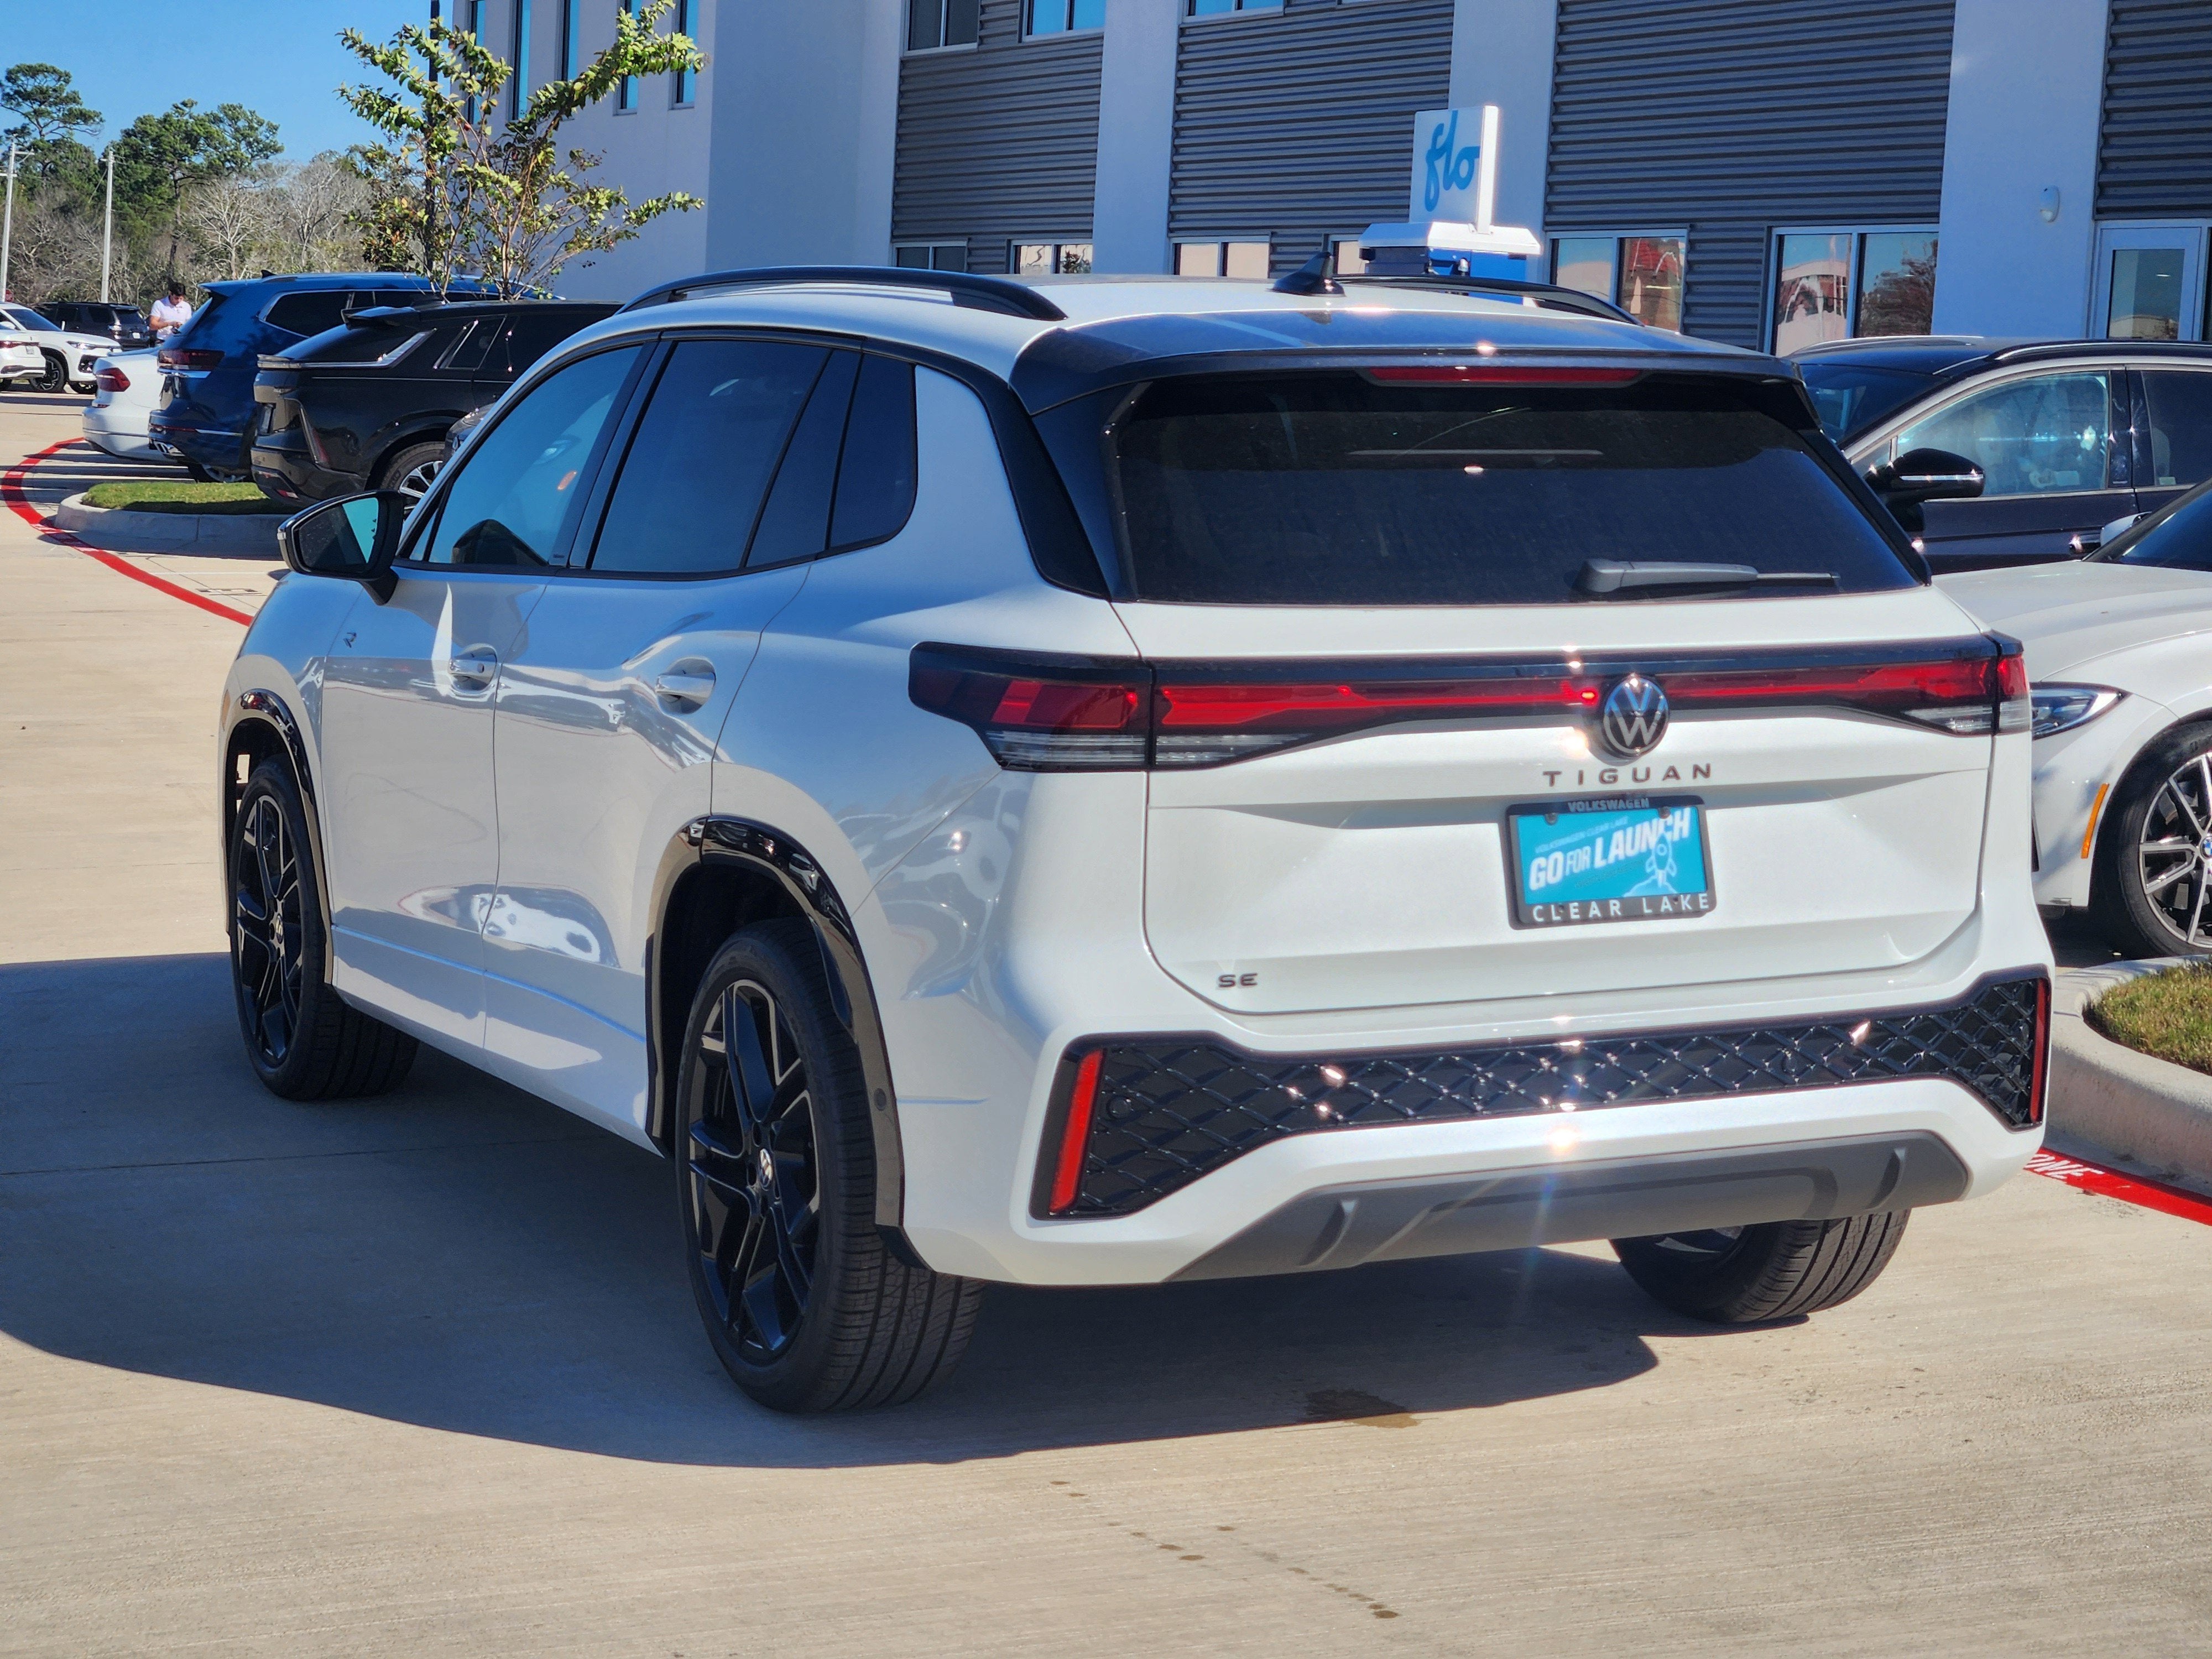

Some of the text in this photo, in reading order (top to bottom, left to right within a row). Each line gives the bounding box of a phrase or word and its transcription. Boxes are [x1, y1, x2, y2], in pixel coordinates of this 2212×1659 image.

[1425, 110, 1480, 212] flo
[1543, 763, 1711, 787] TIGUAN
[1567, 798, 1650, 813] VOLKSWAGEN
[1528, 851, 1565, 891] GO
[1564, 846, 1591, 875] FOR
[1593, 807, 1691, 869] LAUNCH
[1532, 893, 1709, 922] CLEAR LAKE
[1218, 972, 1258, 988] SE
